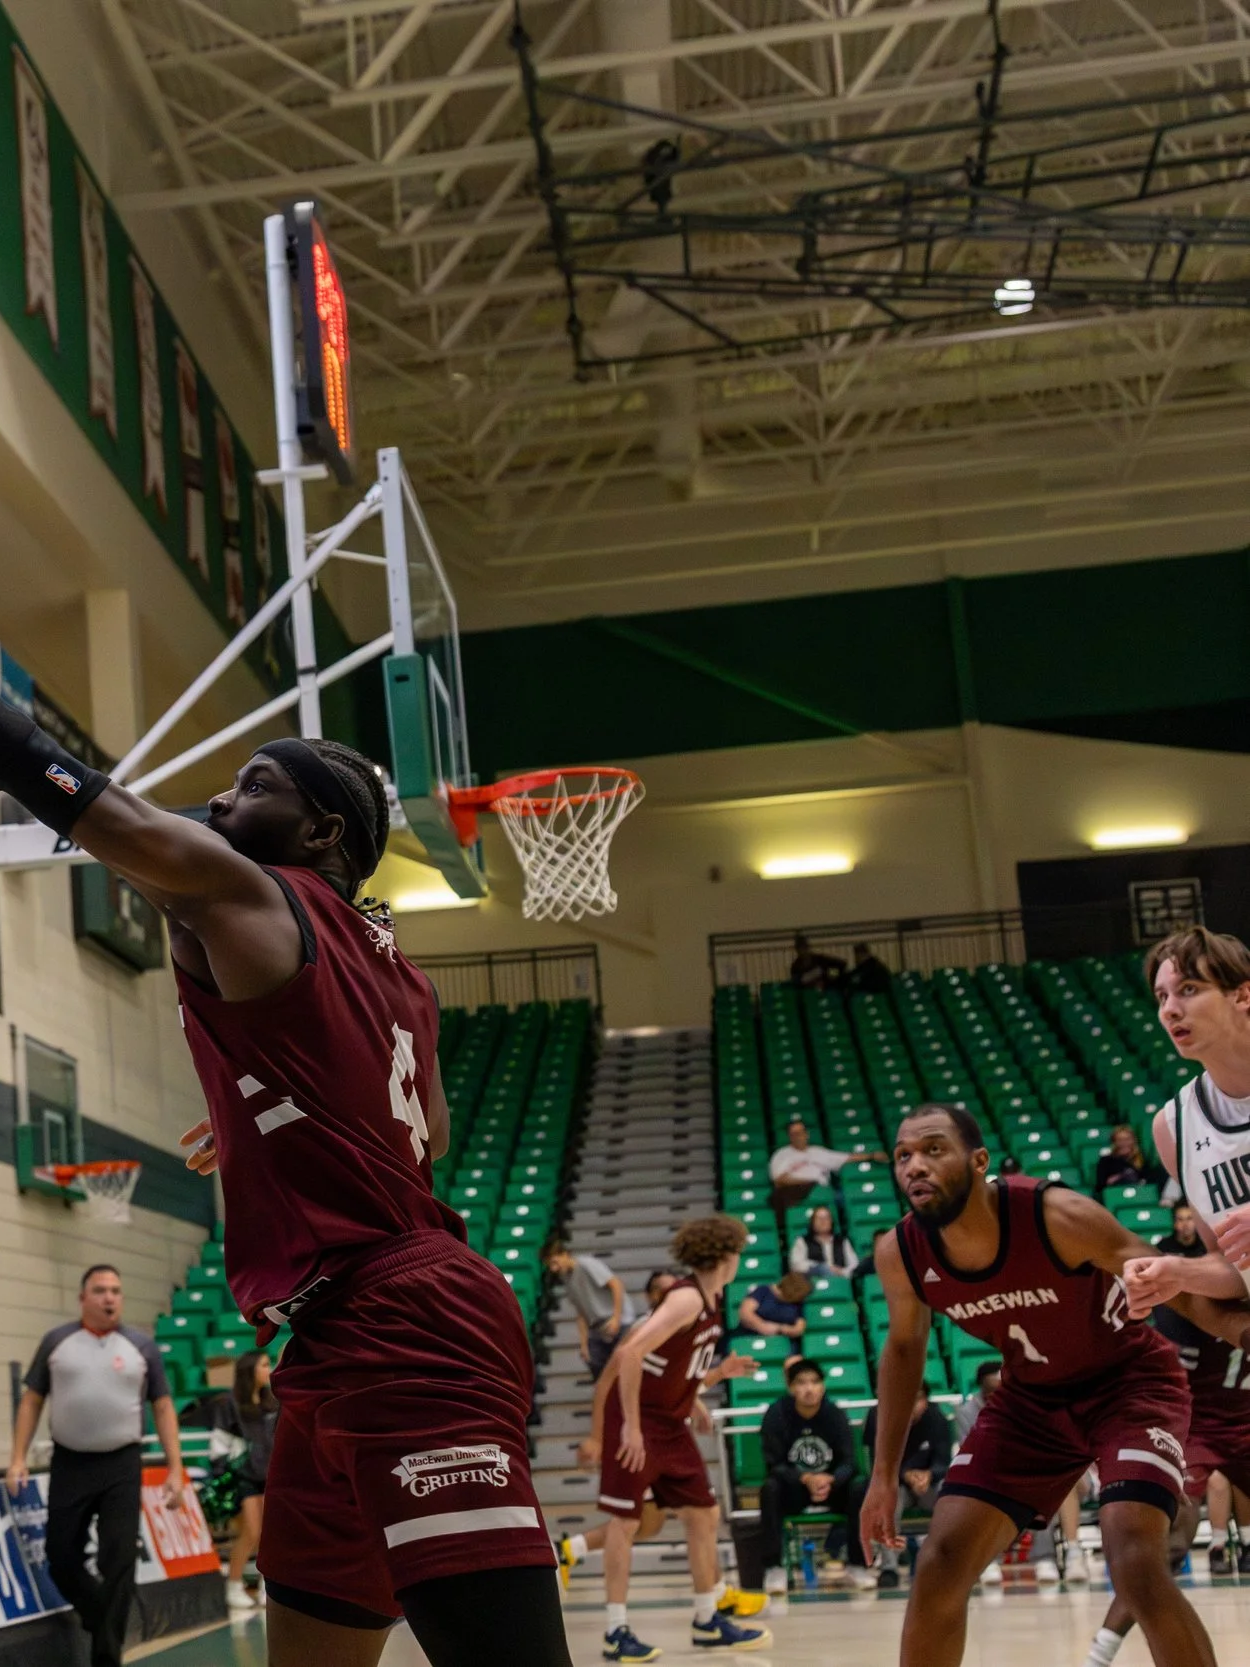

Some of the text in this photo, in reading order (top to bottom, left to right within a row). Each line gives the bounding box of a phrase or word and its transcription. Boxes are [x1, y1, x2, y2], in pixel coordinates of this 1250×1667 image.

[1008, 1323, 1049, 1364] 1
[686, 1342, 716, 1380] 10
[408, 1447, 499, 1469] MacEwan University
[410, 1467, 509, 1498] GRIFFINS
